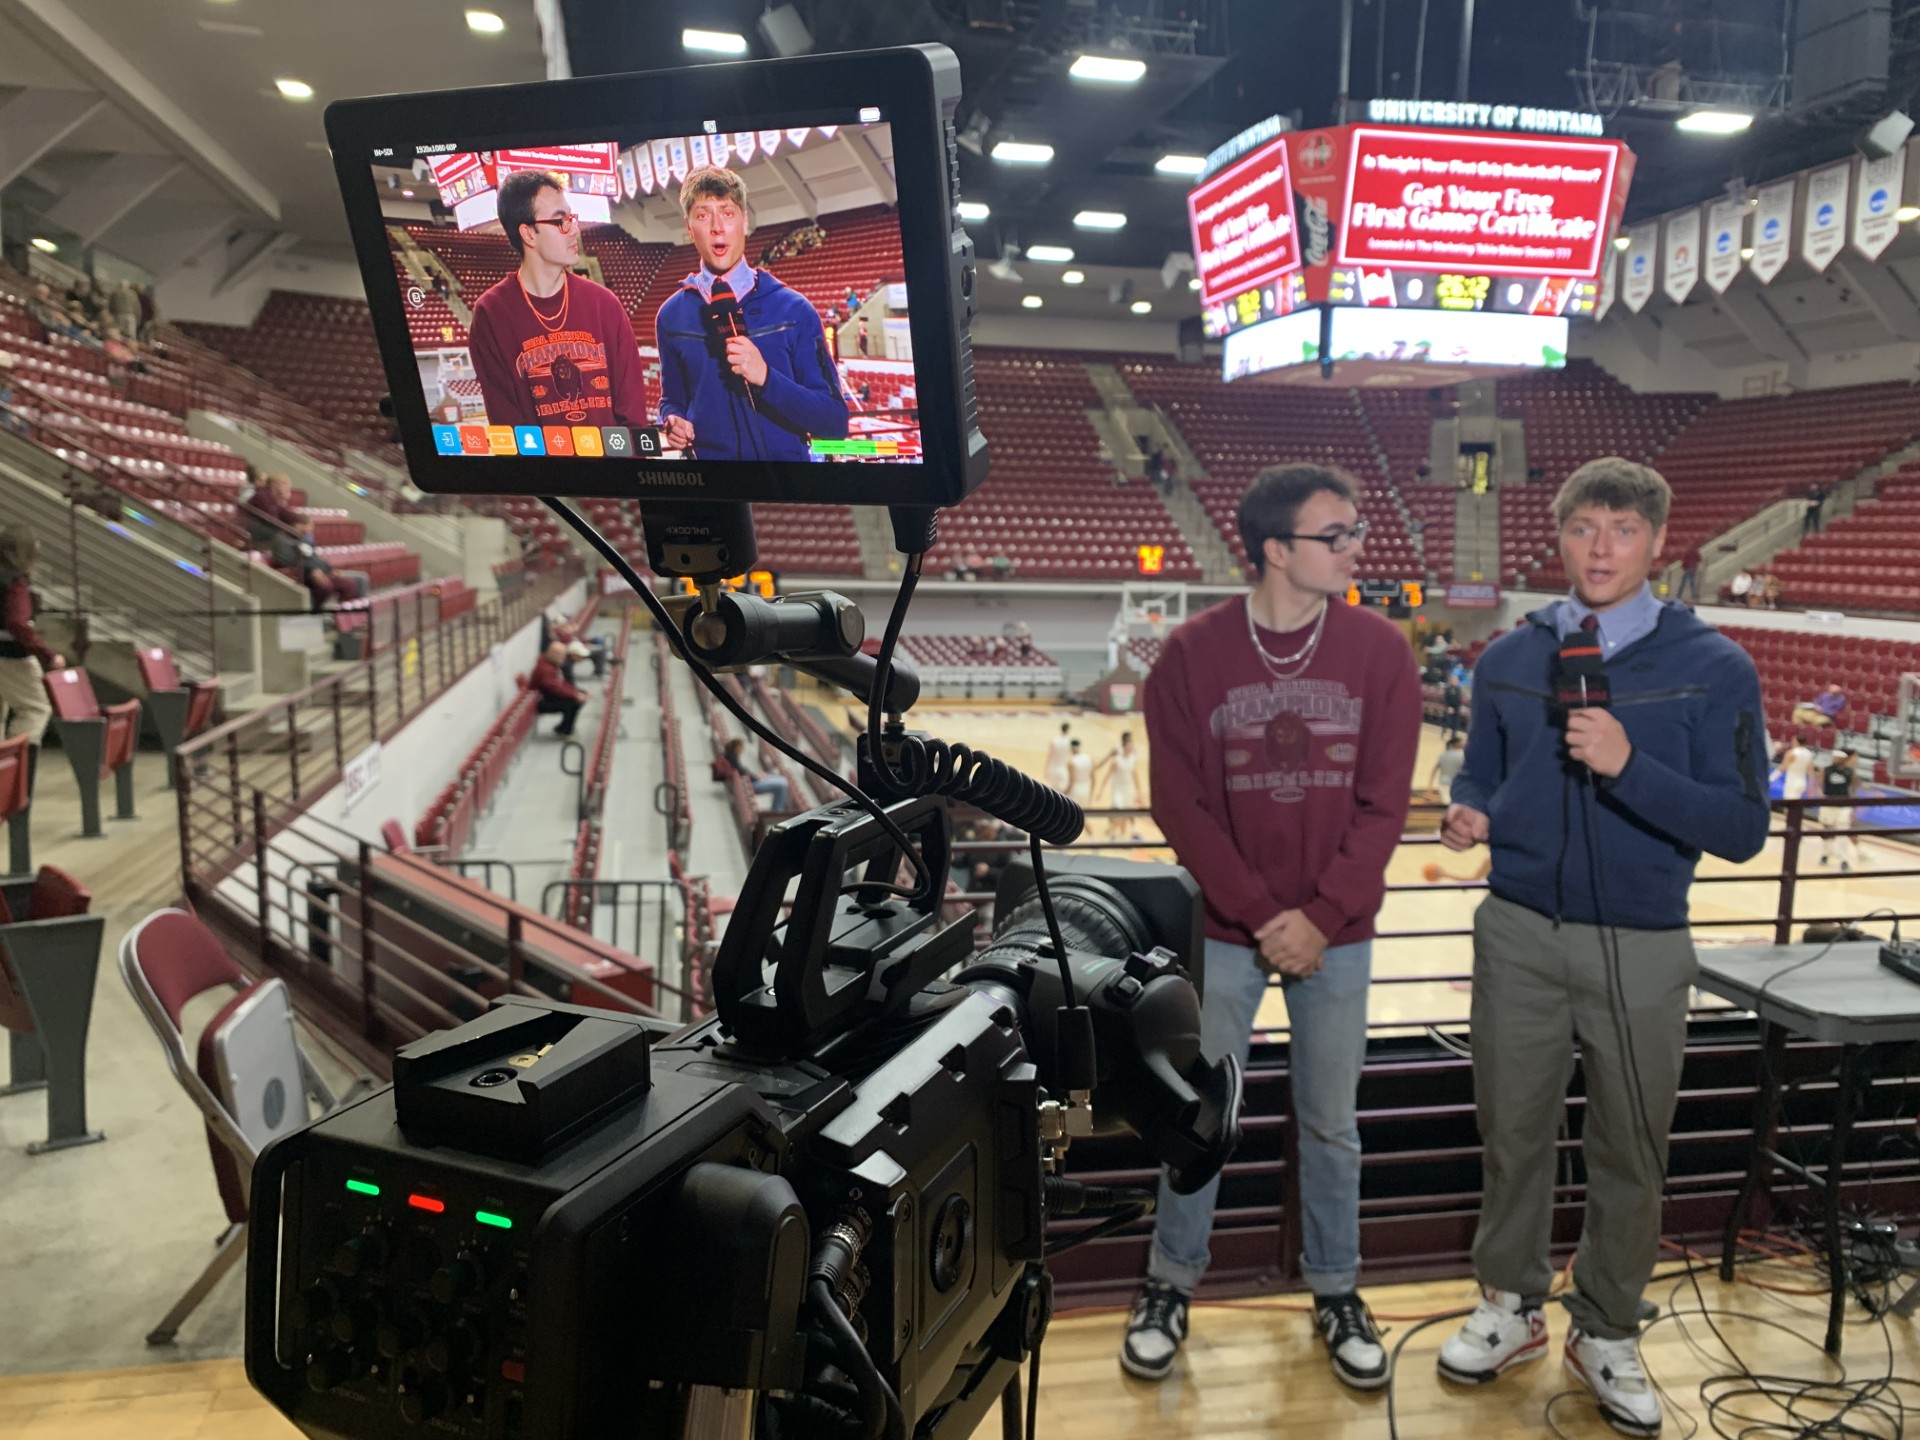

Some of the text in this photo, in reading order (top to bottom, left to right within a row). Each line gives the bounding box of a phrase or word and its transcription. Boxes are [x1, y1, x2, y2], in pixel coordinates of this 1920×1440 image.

[1370, 99, 1603, 136] UNIVERSITY OF MONTANA
[1402, 182, 1554, 213] Get Your Free
[1352, 202, 1596, 240] First Game Certificate
[637, 471, 705, 487] SHIMBOL
